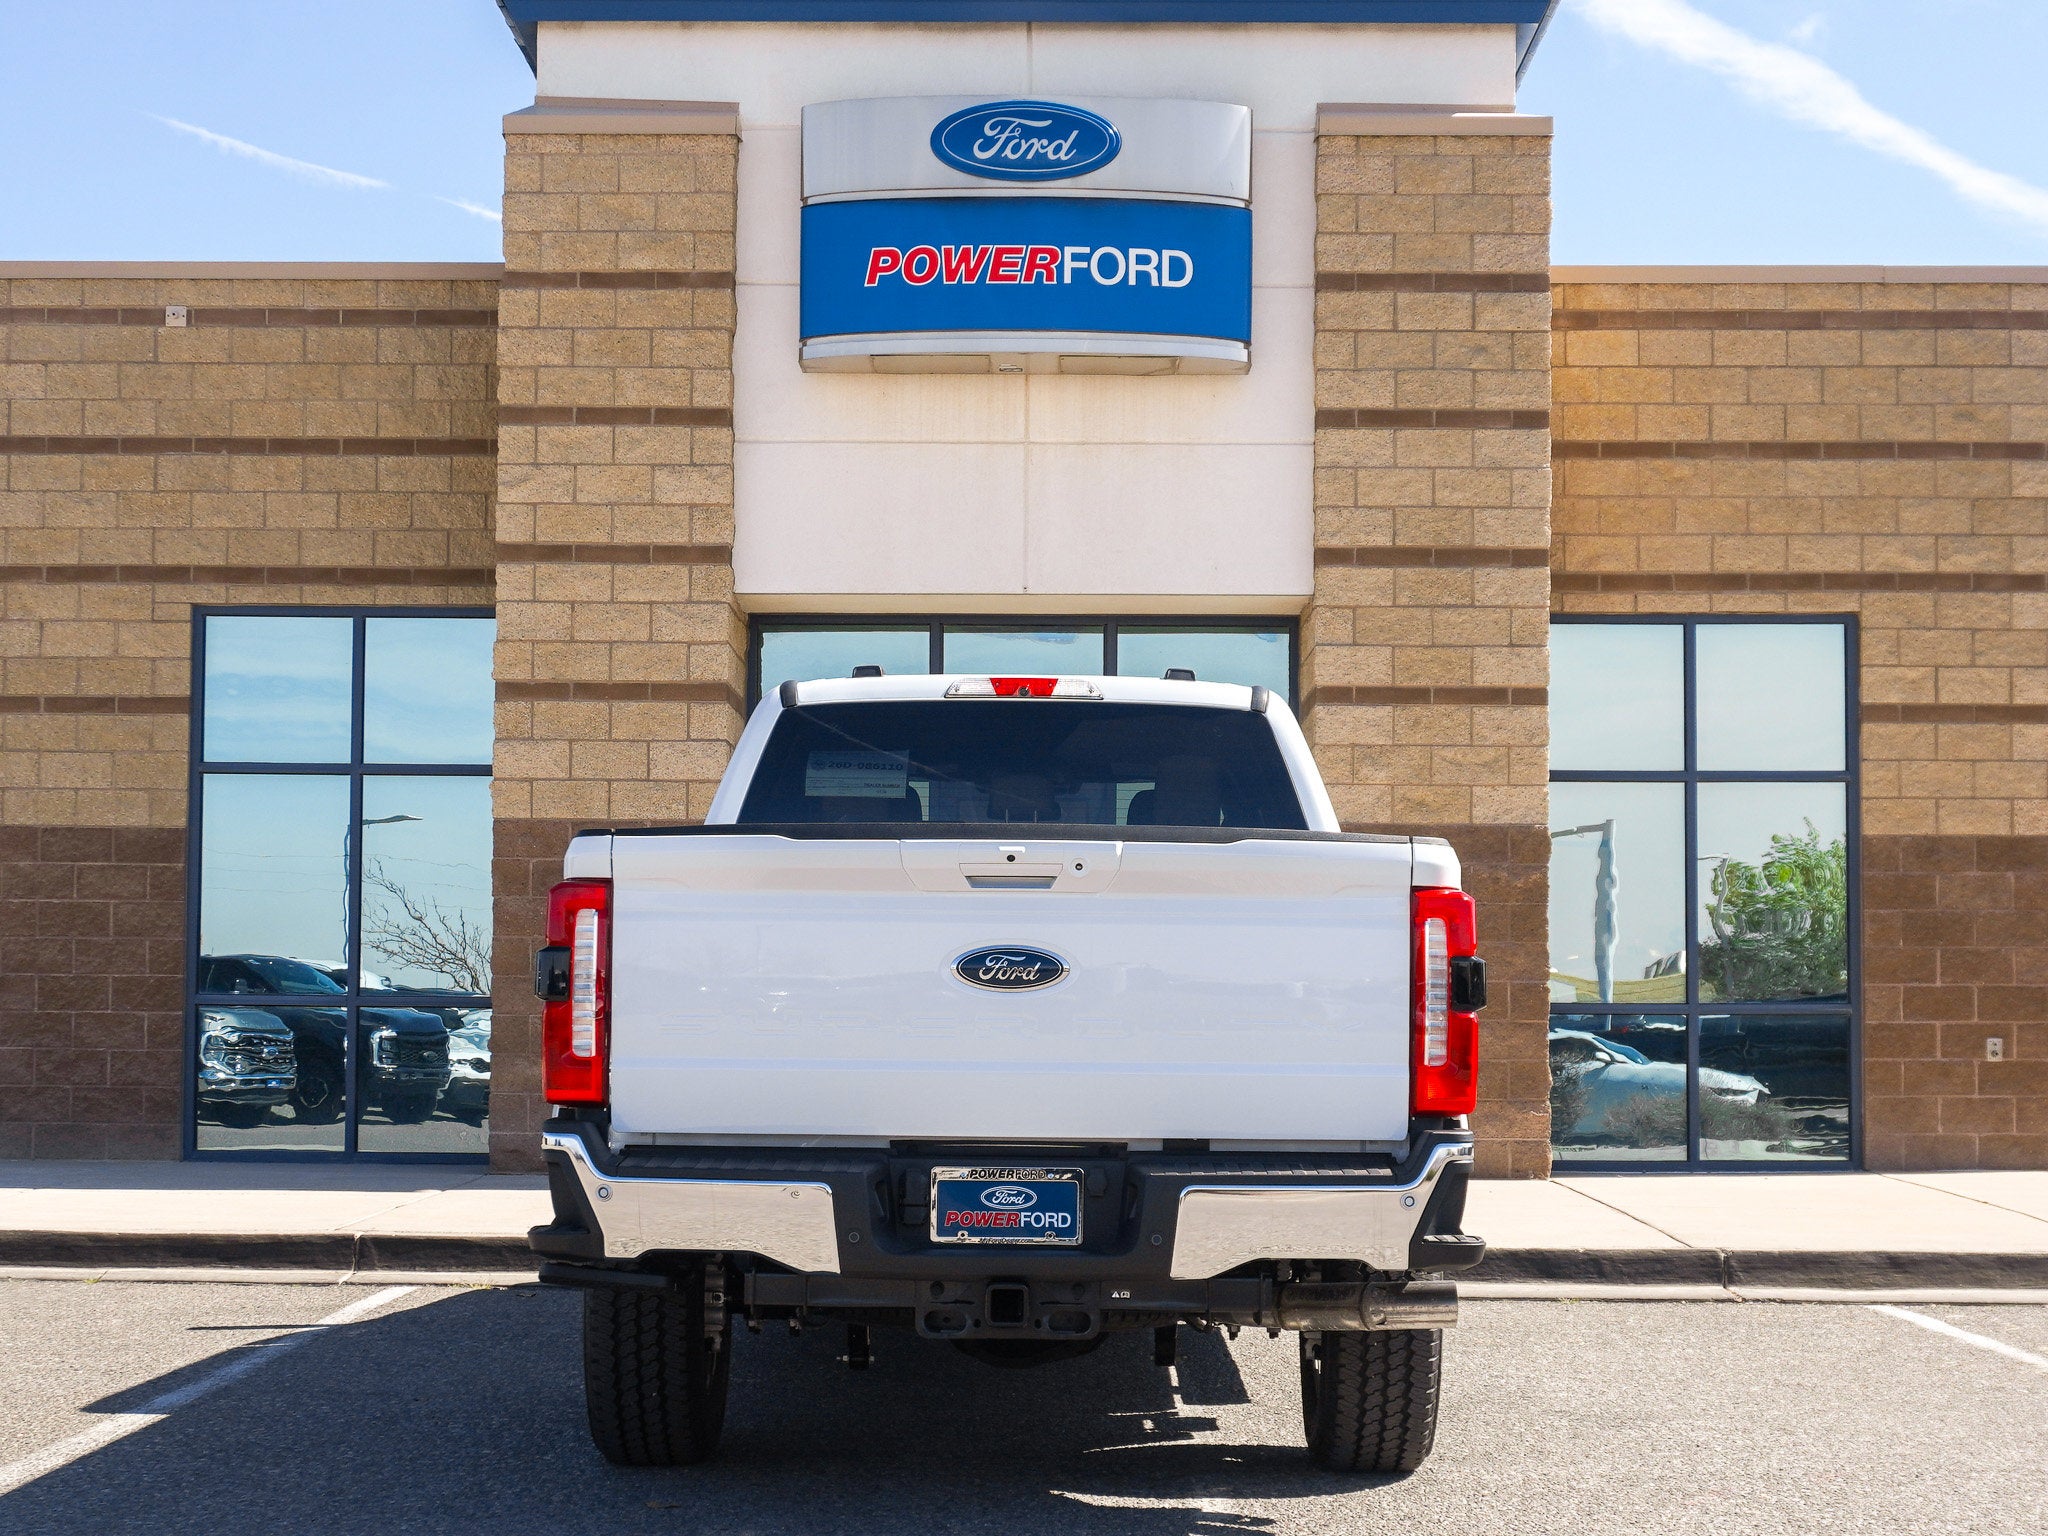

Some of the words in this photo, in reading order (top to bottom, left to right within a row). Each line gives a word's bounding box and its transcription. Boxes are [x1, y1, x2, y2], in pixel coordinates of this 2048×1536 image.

[972, 116, 1079, 162] Ford
[864, 244, 1194, 288] POWERFORD
[978, 954, 1042, 981] Ford
[970, 1169, 1046, 1180] POWERFORD
[992, 1189, 1025, 1205] Ford
[945, 1211, 1071, 1228] POWERFORD
